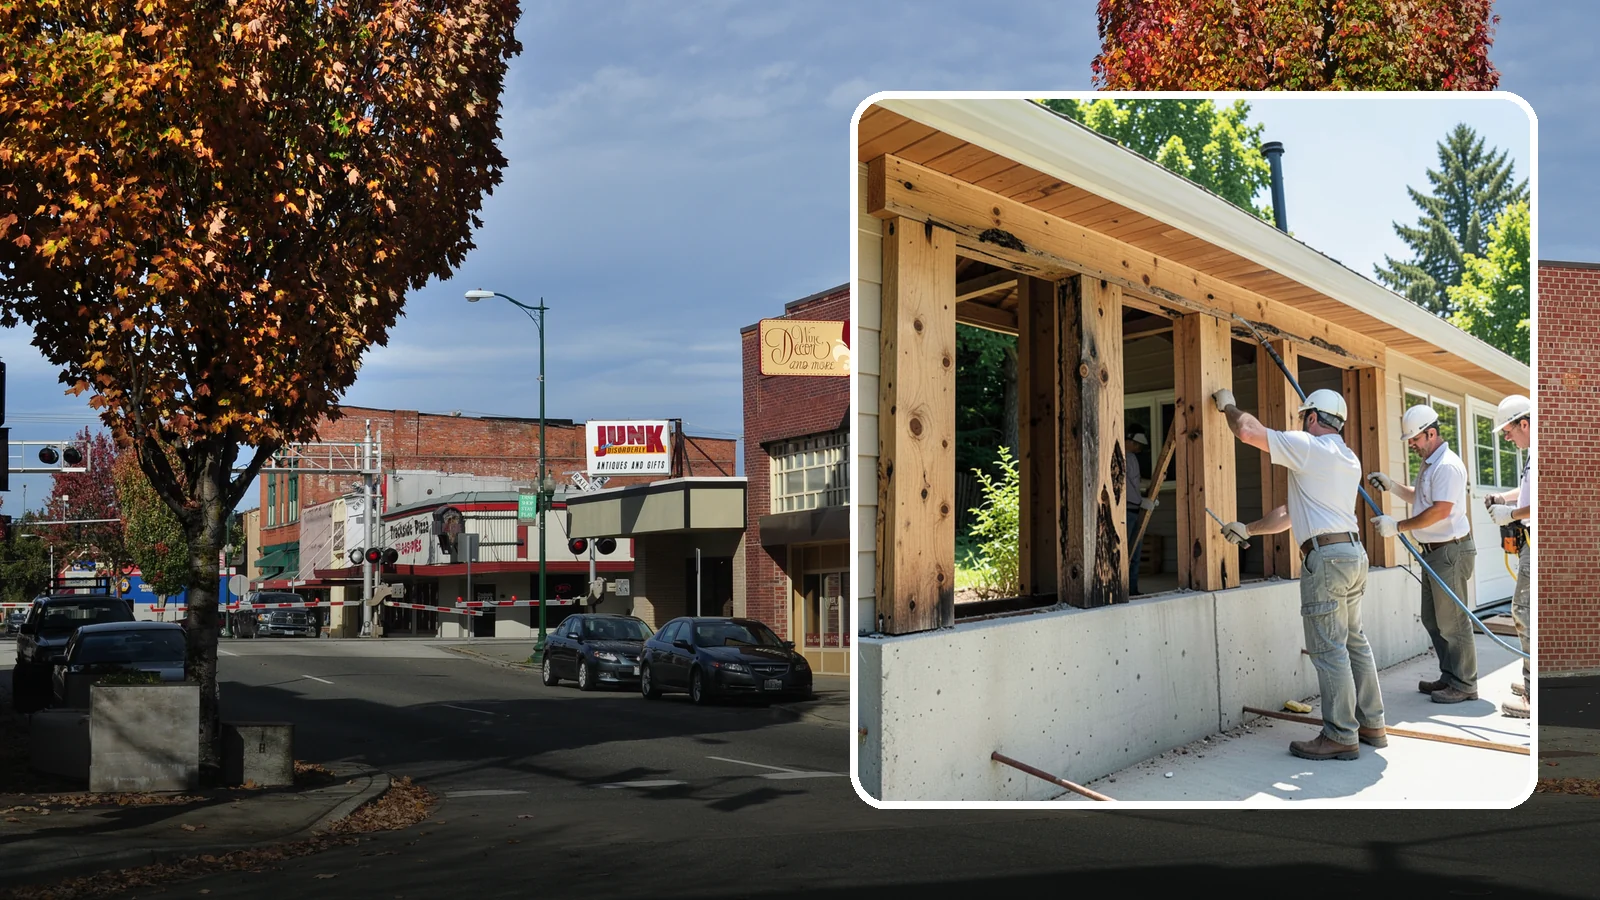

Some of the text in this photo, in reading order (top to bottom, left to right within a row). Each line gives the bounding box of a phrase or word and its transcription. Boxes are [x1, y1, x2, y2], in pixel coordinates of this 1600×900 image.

[764, 328, 831, 365] Decor
[595, 425, 665, 457] JUNK
[607, 445, 646, 454] DISORDERLY
[596, 460, 665, 470] ANTIQUES AND GIFTS
[390, 519, 429, 540] Trackside Pizza
